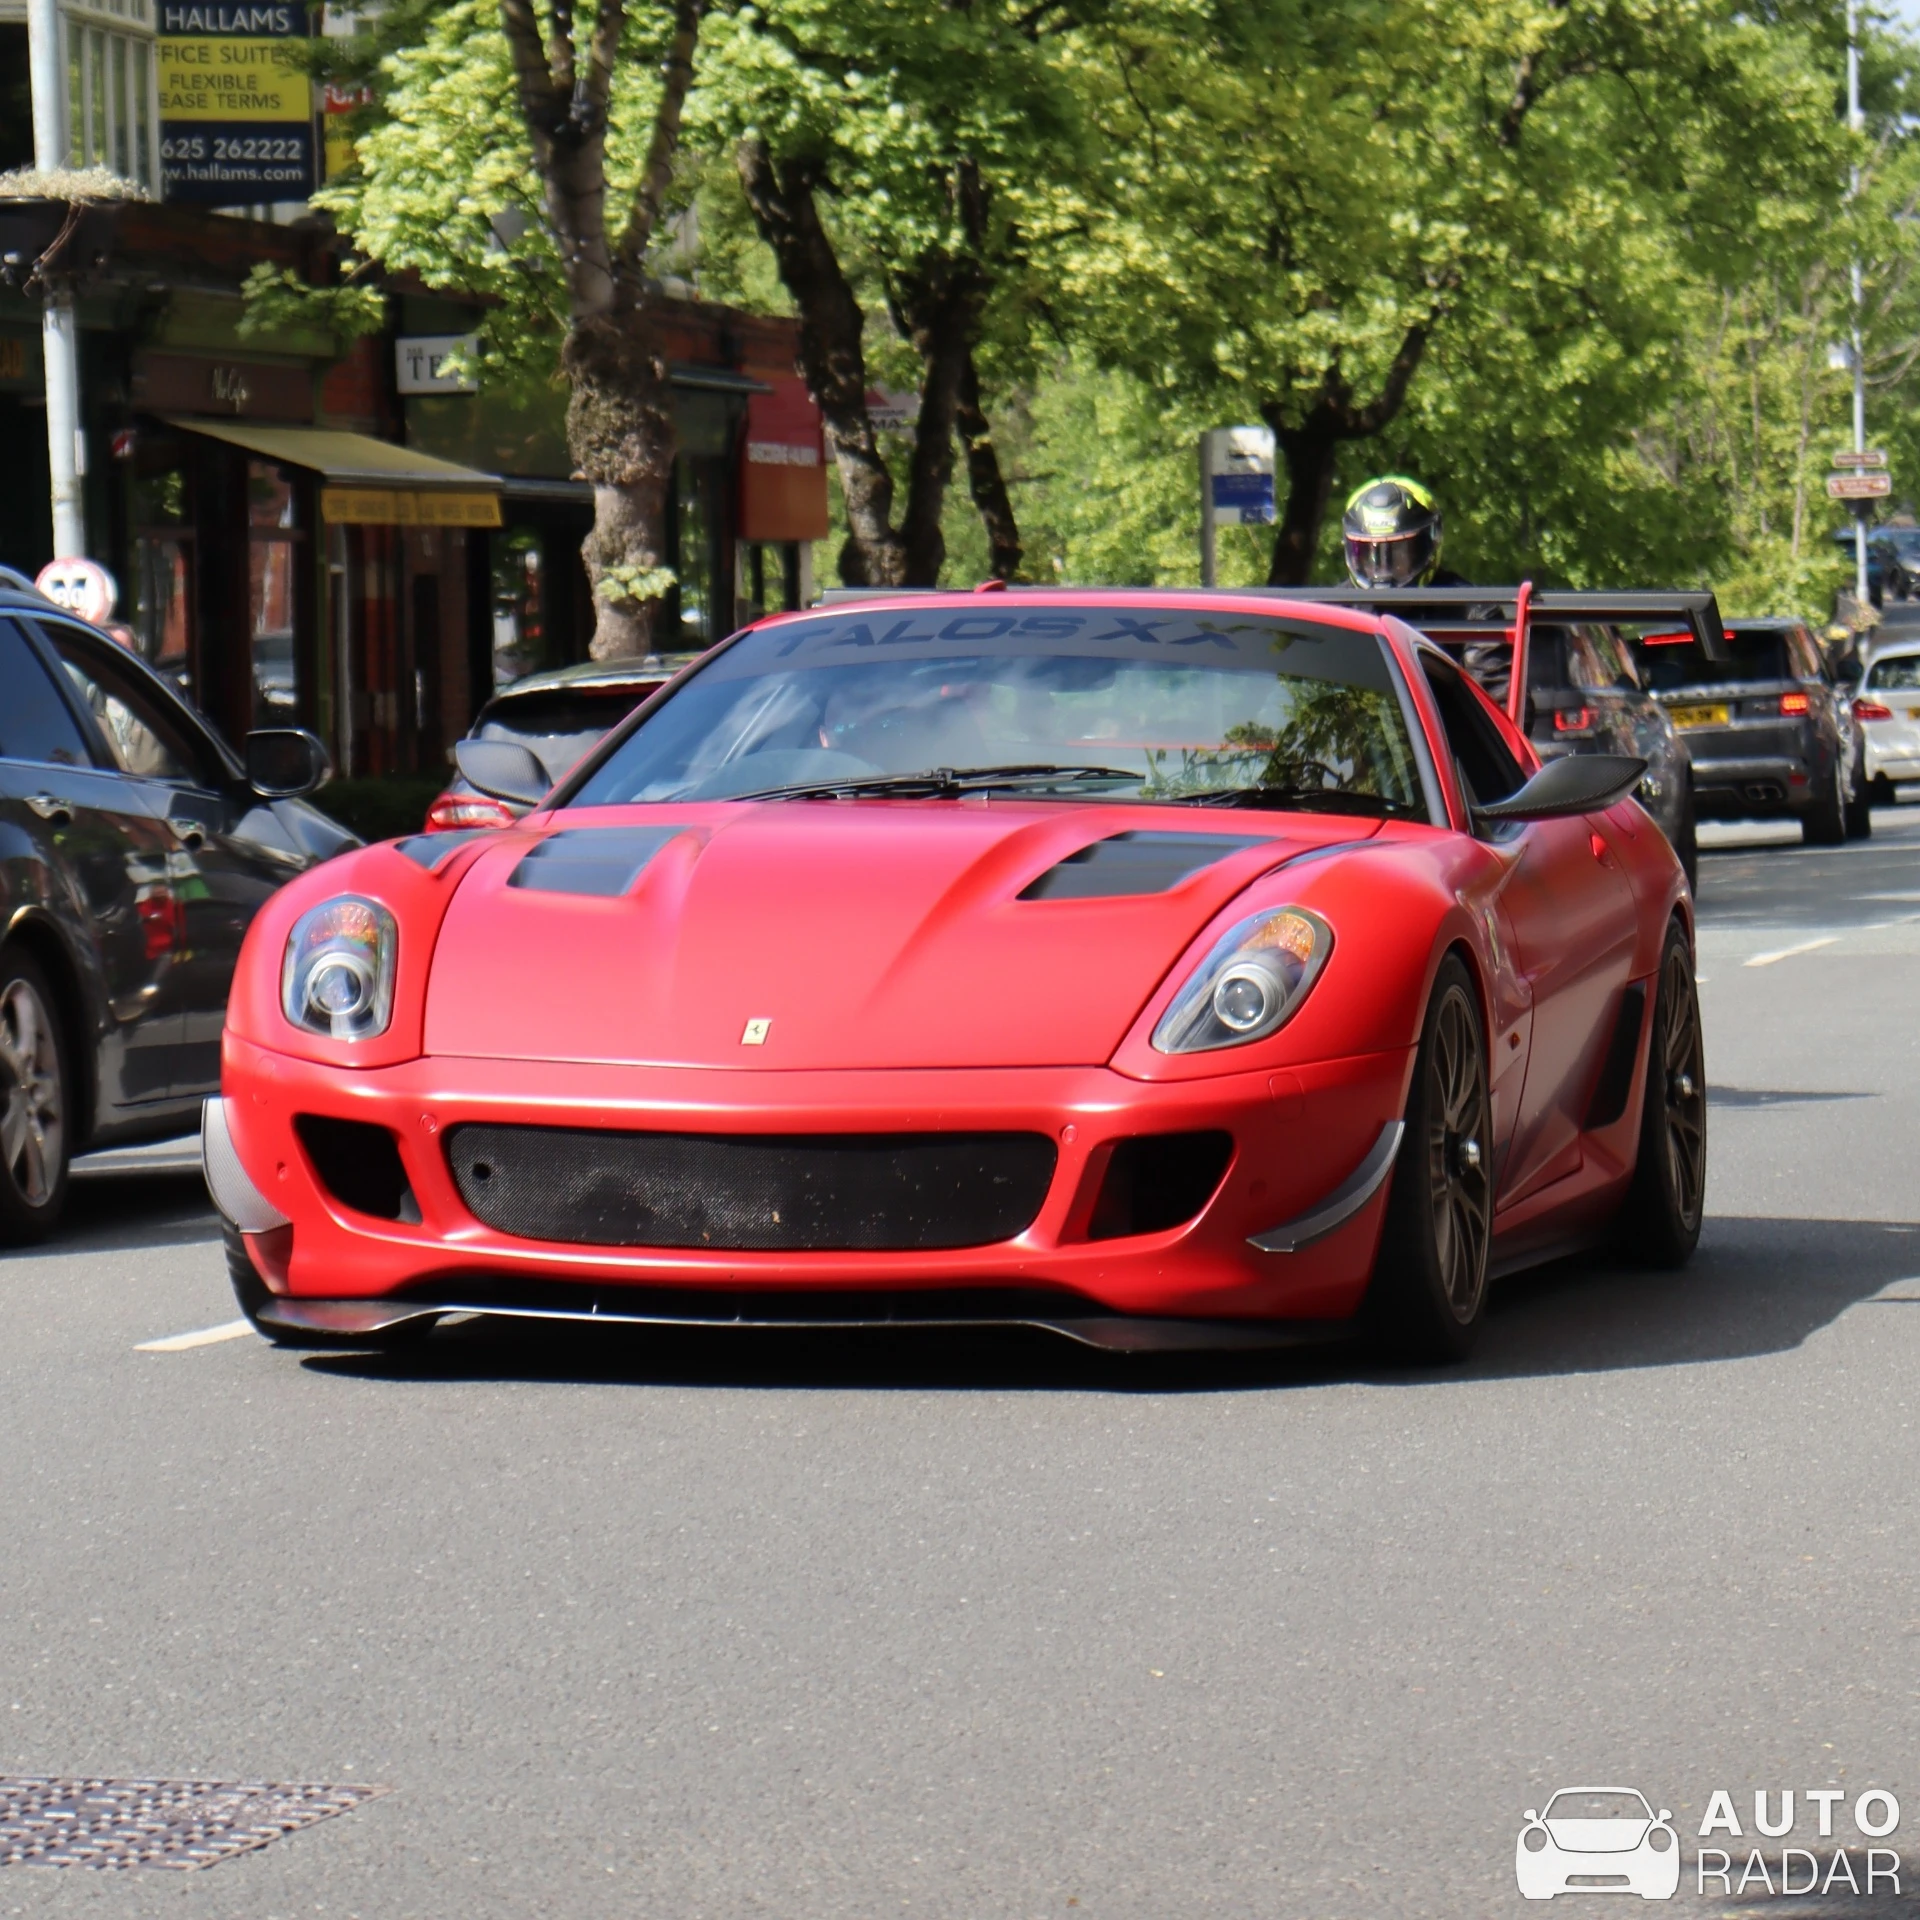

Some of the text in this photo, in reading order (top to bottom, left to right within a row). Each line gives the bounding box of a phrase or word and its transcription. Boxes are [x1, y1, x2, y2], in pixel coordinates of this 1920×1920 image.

[164, 6, 290, 32] HALLAMS
[169, 74, 257, 91] FLEXIBLE
[158, 93, 281, 109] EASE TERMS
[160, 138, 302, 160] 625 262222
[406, 355, 455, 380] TE
[774, 616, 1087, 658] TALOS
